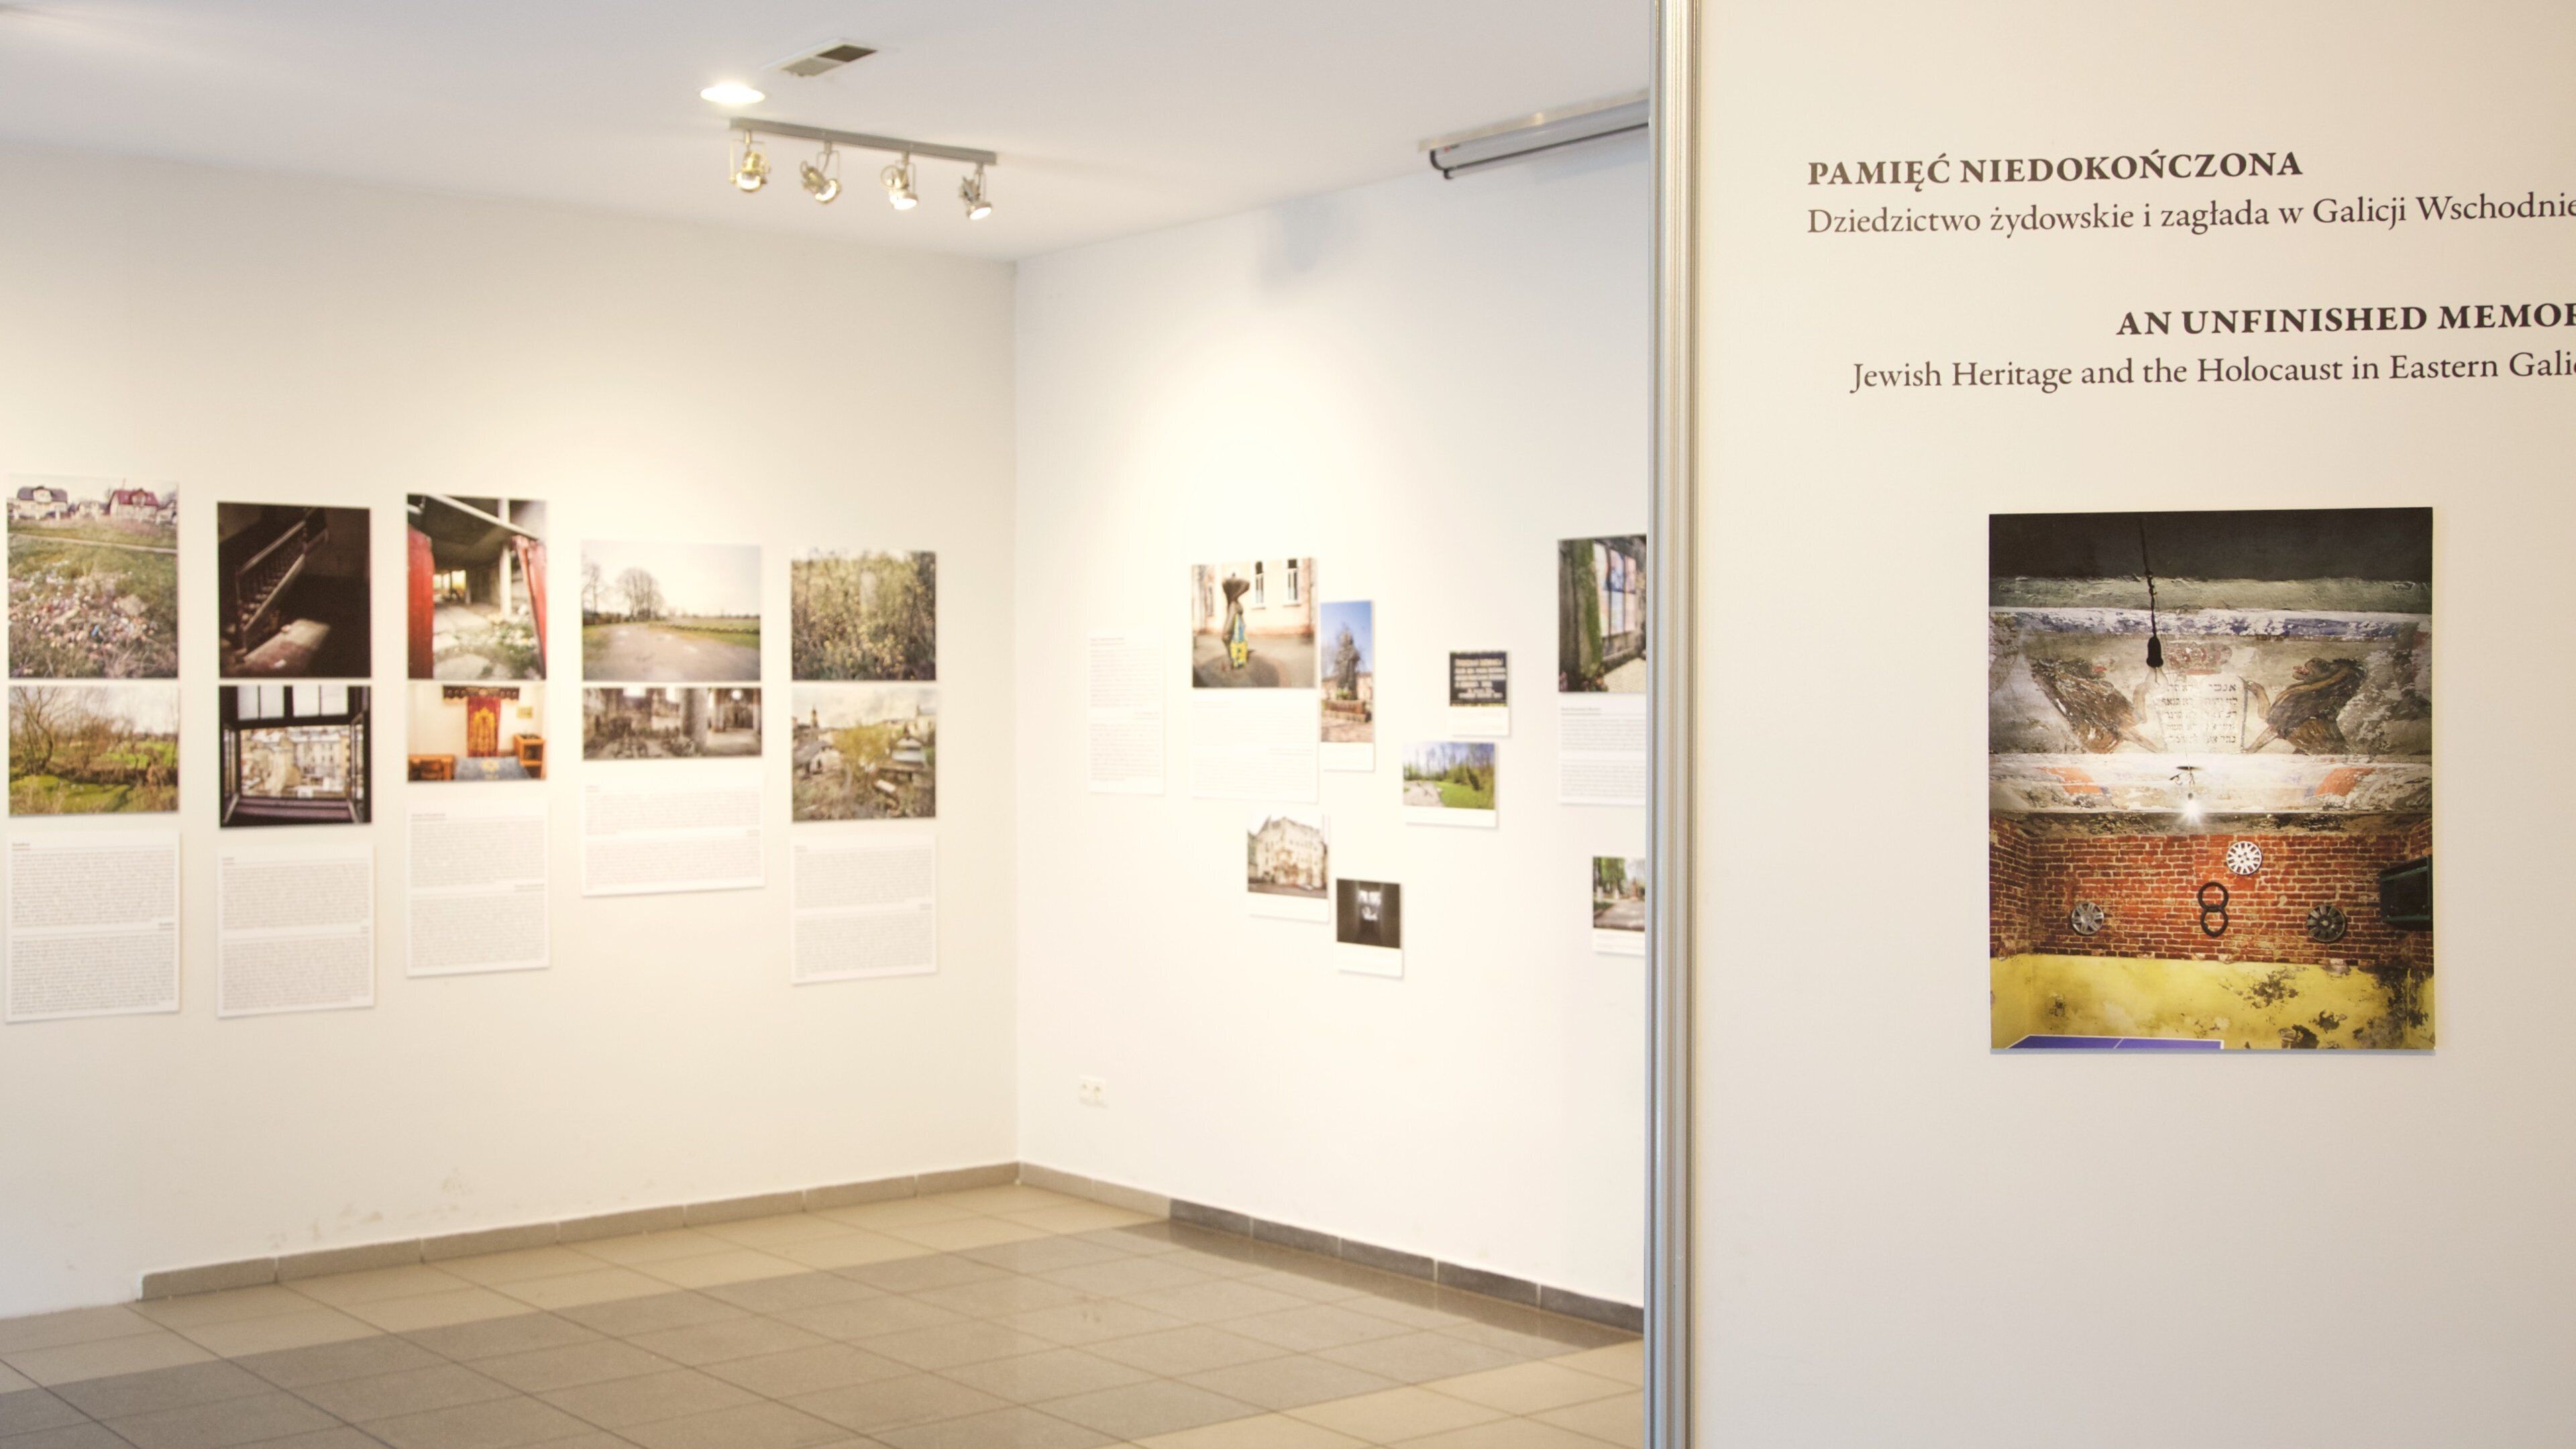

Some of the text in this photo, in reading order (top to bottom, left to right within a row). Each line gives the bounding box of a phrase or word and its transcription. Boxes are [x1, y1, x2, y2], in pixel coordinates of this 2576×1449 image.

[1807, 148, 2304, 193] PAMIĘĆ NIEDOKOŃCZONA
[1807, 206, 1981, 233] Dziedzictwo
[1990, 202, 2134, 239] żydowskie
[2143, 202, 2151, 227] i
[2161, 199, 2270, 235] zagłada
[2277, 207, 2304, 224] w
[2312, 195, 2407, 231] Galicji
[2115, 311, 2172, 335] AN
[2181, 306, 2427, 335] UNFINISHED
[1849, 350, 2576, 394] Jewish Heritage and the Holocaust in Eastern Gali
